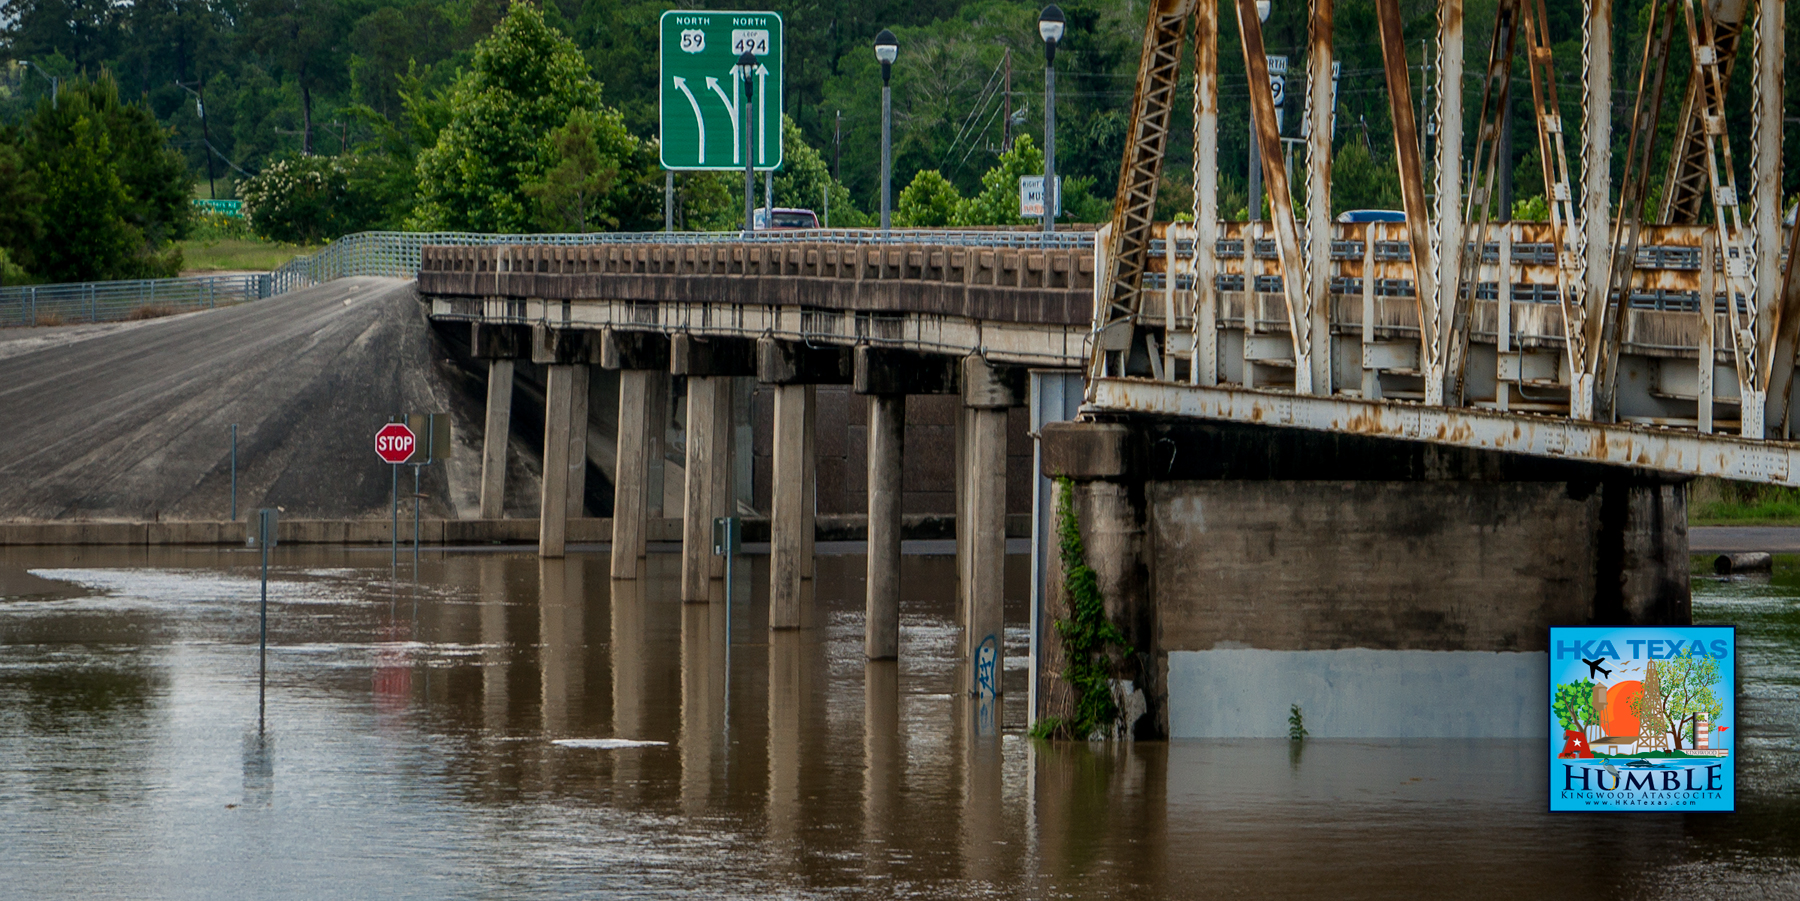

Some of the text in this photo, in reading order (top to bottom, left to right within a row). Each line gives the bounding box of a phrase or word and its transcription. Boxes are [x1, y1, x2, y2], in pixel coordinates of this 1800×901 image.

[676, 16, 710, 26] NORTH
[732, 17, 767, 27] NORTH
[683, 34, 703, 48] 59
[735, 39, 766, 52] 494
[378, 435, 412, 451] STOP
